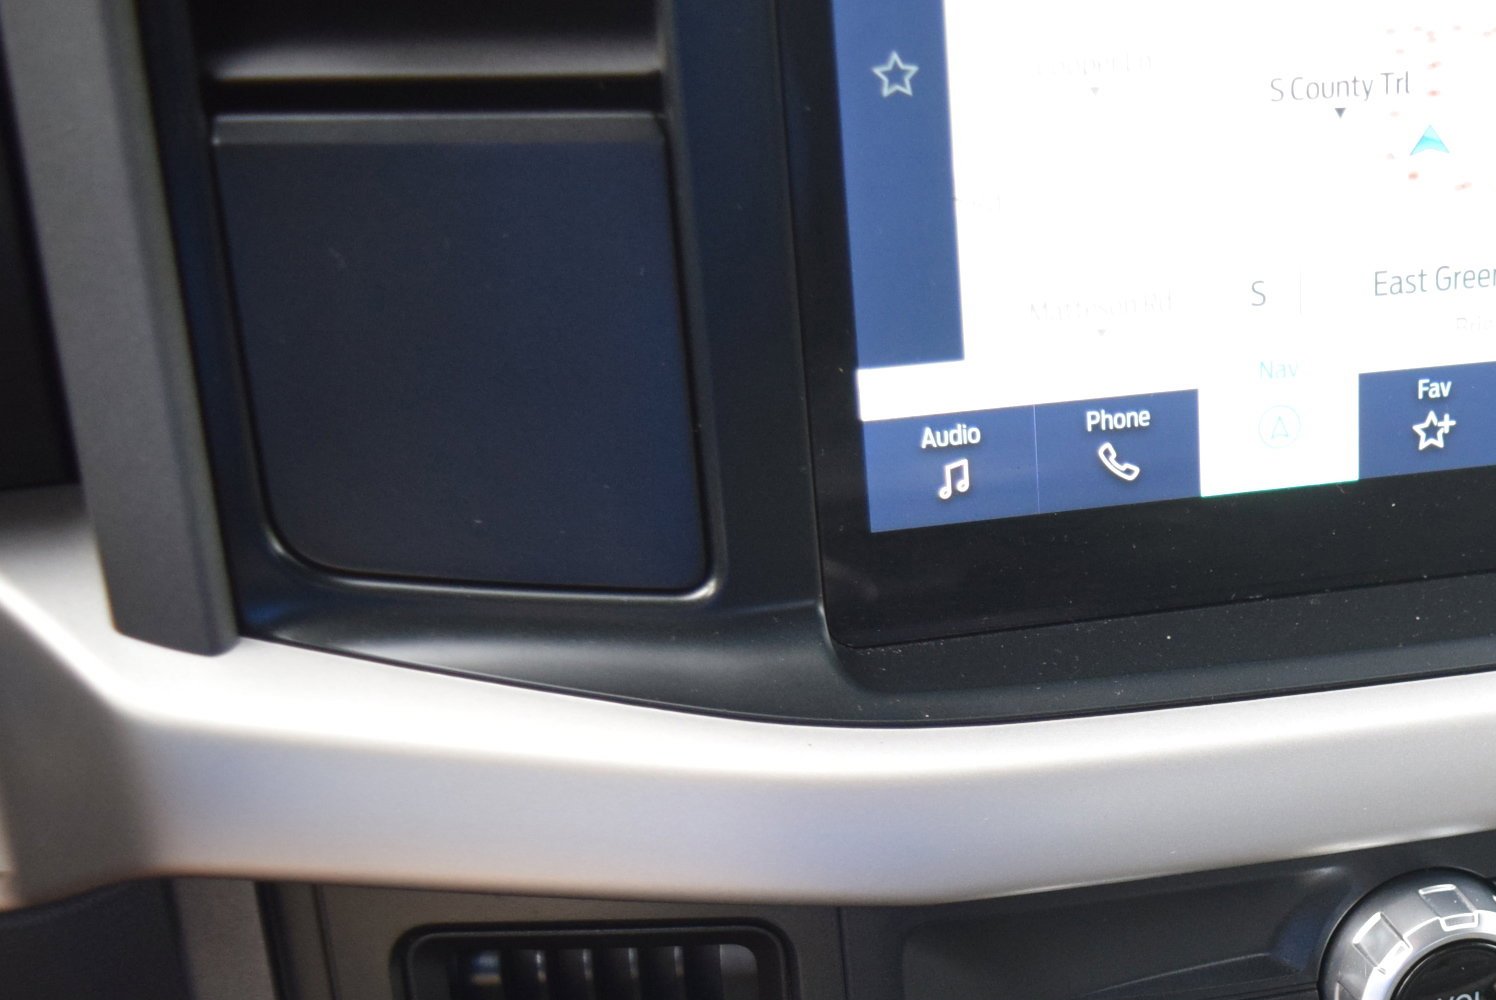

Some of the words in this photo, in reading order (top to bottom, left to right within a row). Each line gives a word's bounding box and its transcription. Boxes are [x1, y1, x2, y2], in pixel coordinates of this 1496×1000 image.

[1270, 78, 1285, 102] S
[1290, 76, 1374, 101] County
[1380, 71, 1410, 95] Trl
[1251, 280, 1267, 307] S
[1374, 269, 1428, 297] East
[1258, 358, 1300, 382] Nav
[1417, 378, 1452, 400] Fav
[1085, 408, 1151, 432] Phone
[920, 424, 982, 449] Audio
